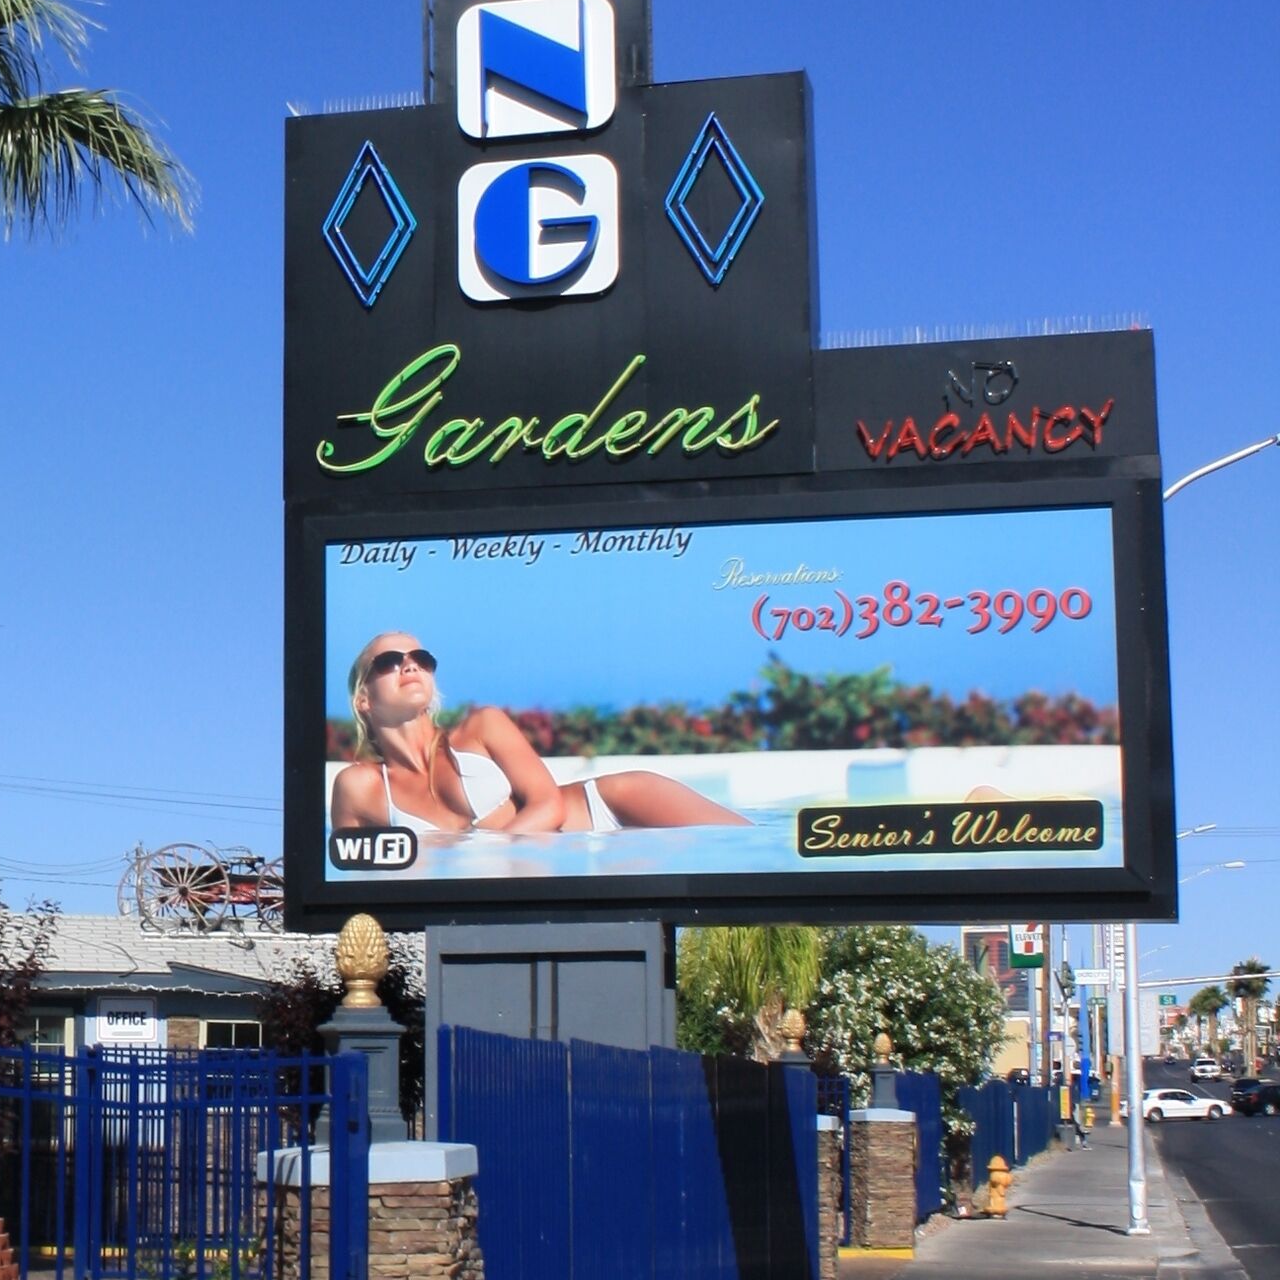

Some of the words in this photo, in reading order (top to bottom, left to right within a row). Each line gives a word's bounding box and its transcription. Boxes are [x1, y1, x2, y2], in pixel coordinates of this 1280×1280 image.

[945, 360, 1018, 408] NO
[316, 343, 779, 474] Gardens
[856, 397, 1114, 462] VACANCY
[340, 540, 417, 571] Daily
[447, 532, 546, 566] Weekly
[571, 524, 694, 558] Monthly
[751, 580, 1093, 641] (702)382-3990
[804, 811, 936, 850] Senior's
[951, 809, 1097, 846] Welcome
[107, 1010, 147, 1026] OFFICE
